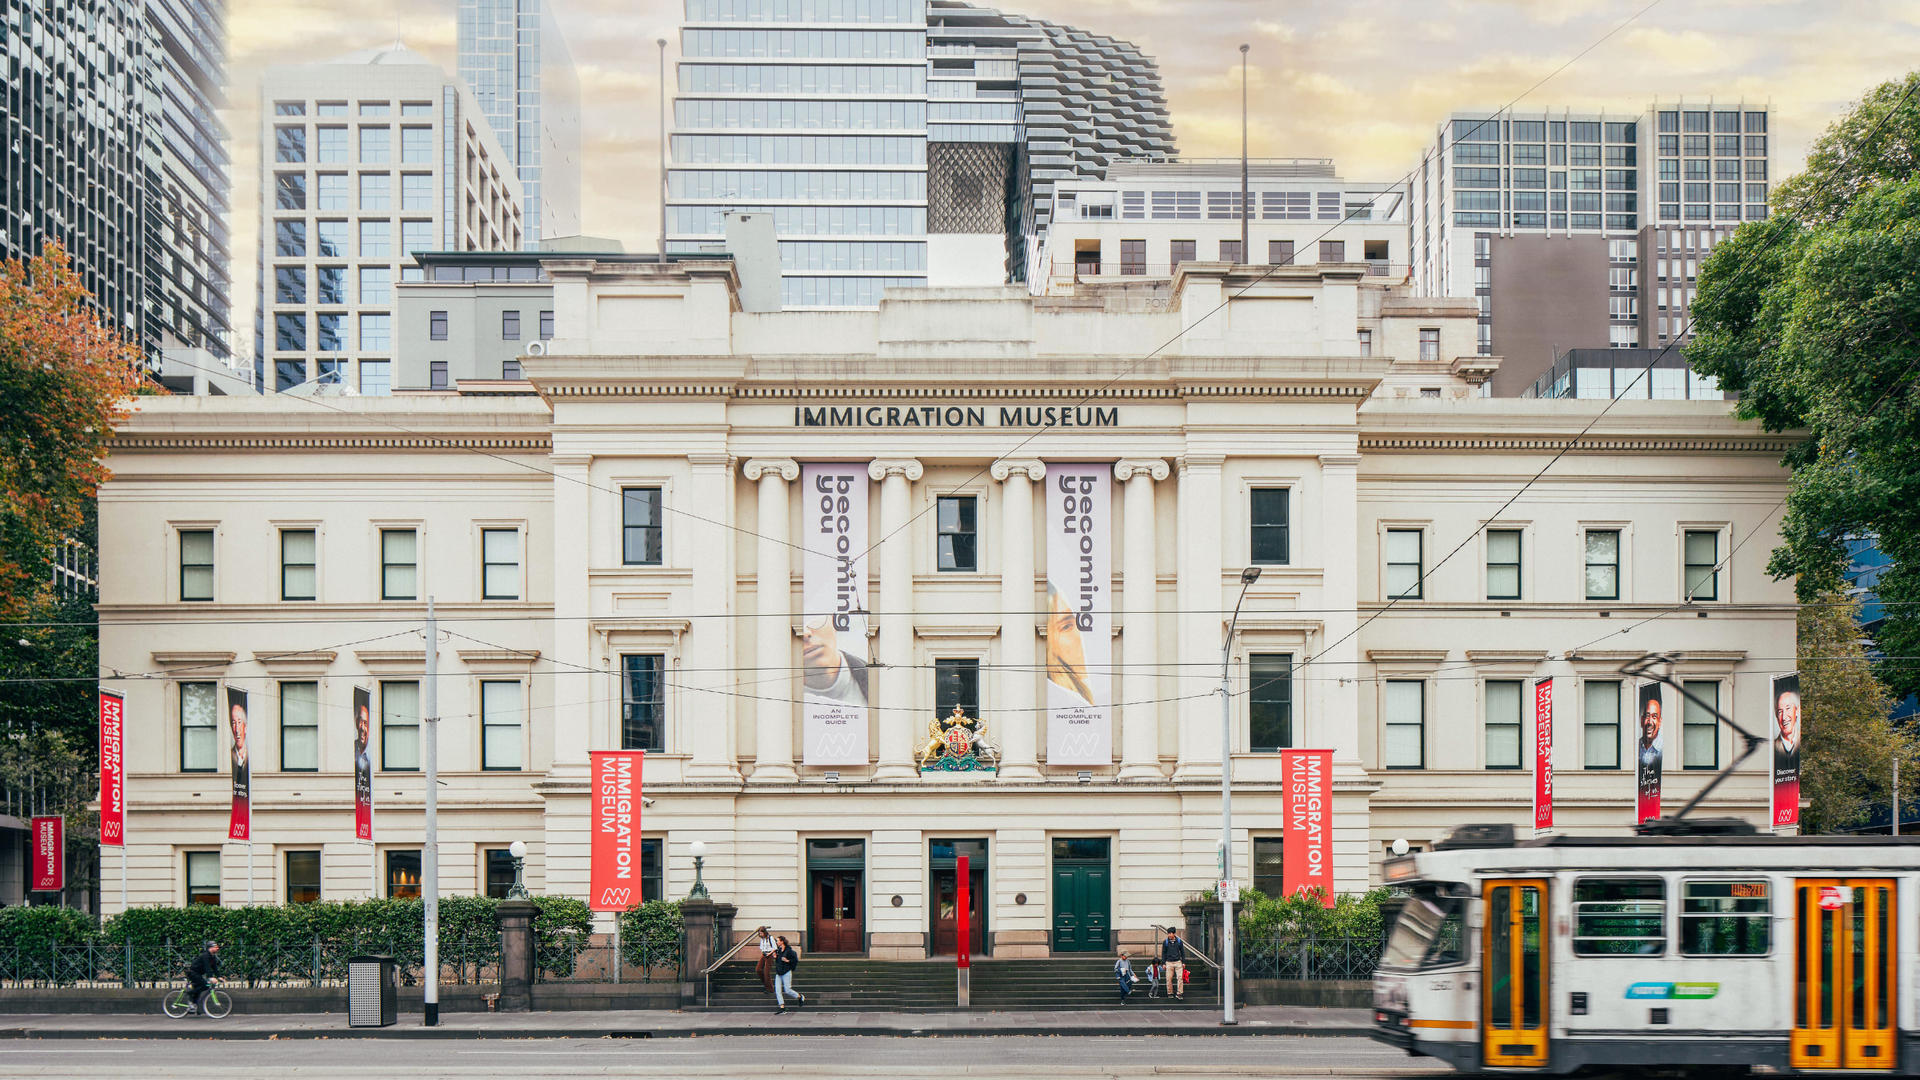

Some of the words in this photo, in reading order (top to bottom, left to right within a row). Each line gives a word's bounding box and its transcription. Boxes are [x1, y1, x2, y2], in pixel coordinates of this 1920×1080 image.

[794, 406, 985, 427] IMMIGRATION
[1000, 406, 1119, 427] MUSEUM
[816, 474, 834, 534] you
[1059, 474, 1077, 534] you
[833, 475, 856, 632] becoming
[1076, 475, 1099, 632] becoming
[103, 700, 112, 770] MUSEUM
[112, 700, 121, 813] IMMIGRATION
[1776, 768, 1796, 776] Discover
[601, 757, 617, 833] MUSEUM
[616, 757, 632, 879] IMMIGRATION
[1292, 755, 1306, 831] MUSEUM
[1308, 755, 1322, 877] IMMIGRATION
[47, 821, 55, 875] IMMIGRATION
